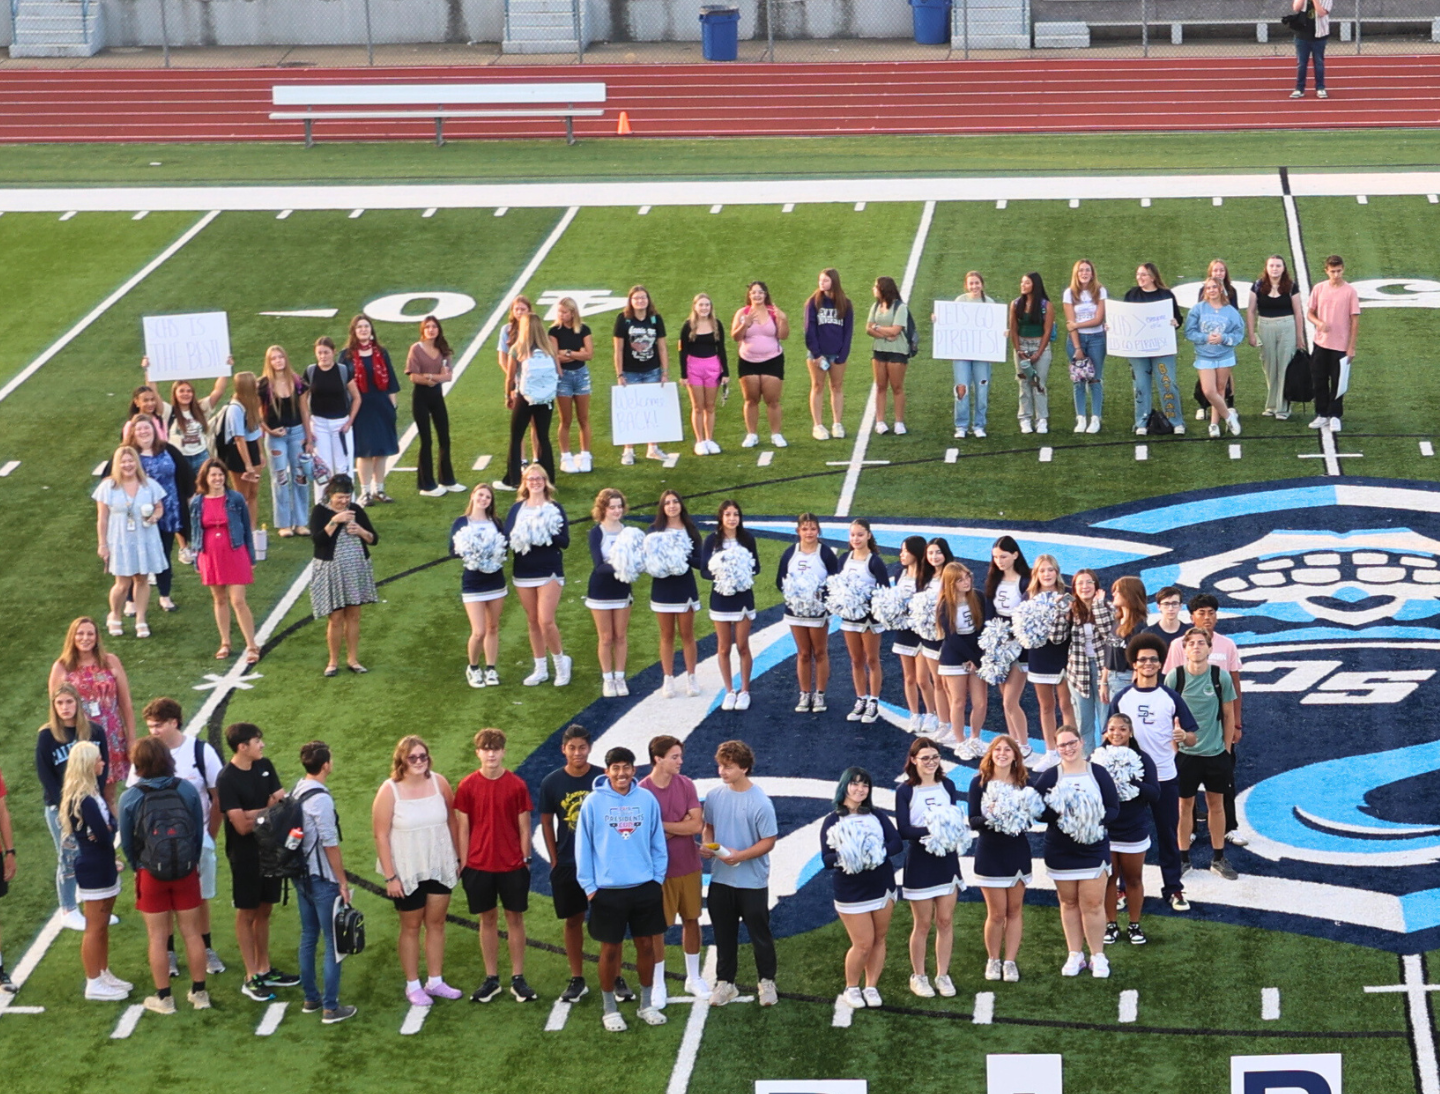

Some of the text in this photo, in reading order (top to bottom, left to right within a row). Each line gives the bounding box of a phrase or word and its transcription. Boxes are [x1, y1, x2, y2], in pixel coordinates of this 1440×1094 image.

[975, 304, 994, 329] GO
[148, 341, 182, 372] THE
[1138, 705, 1154, 725] SC
